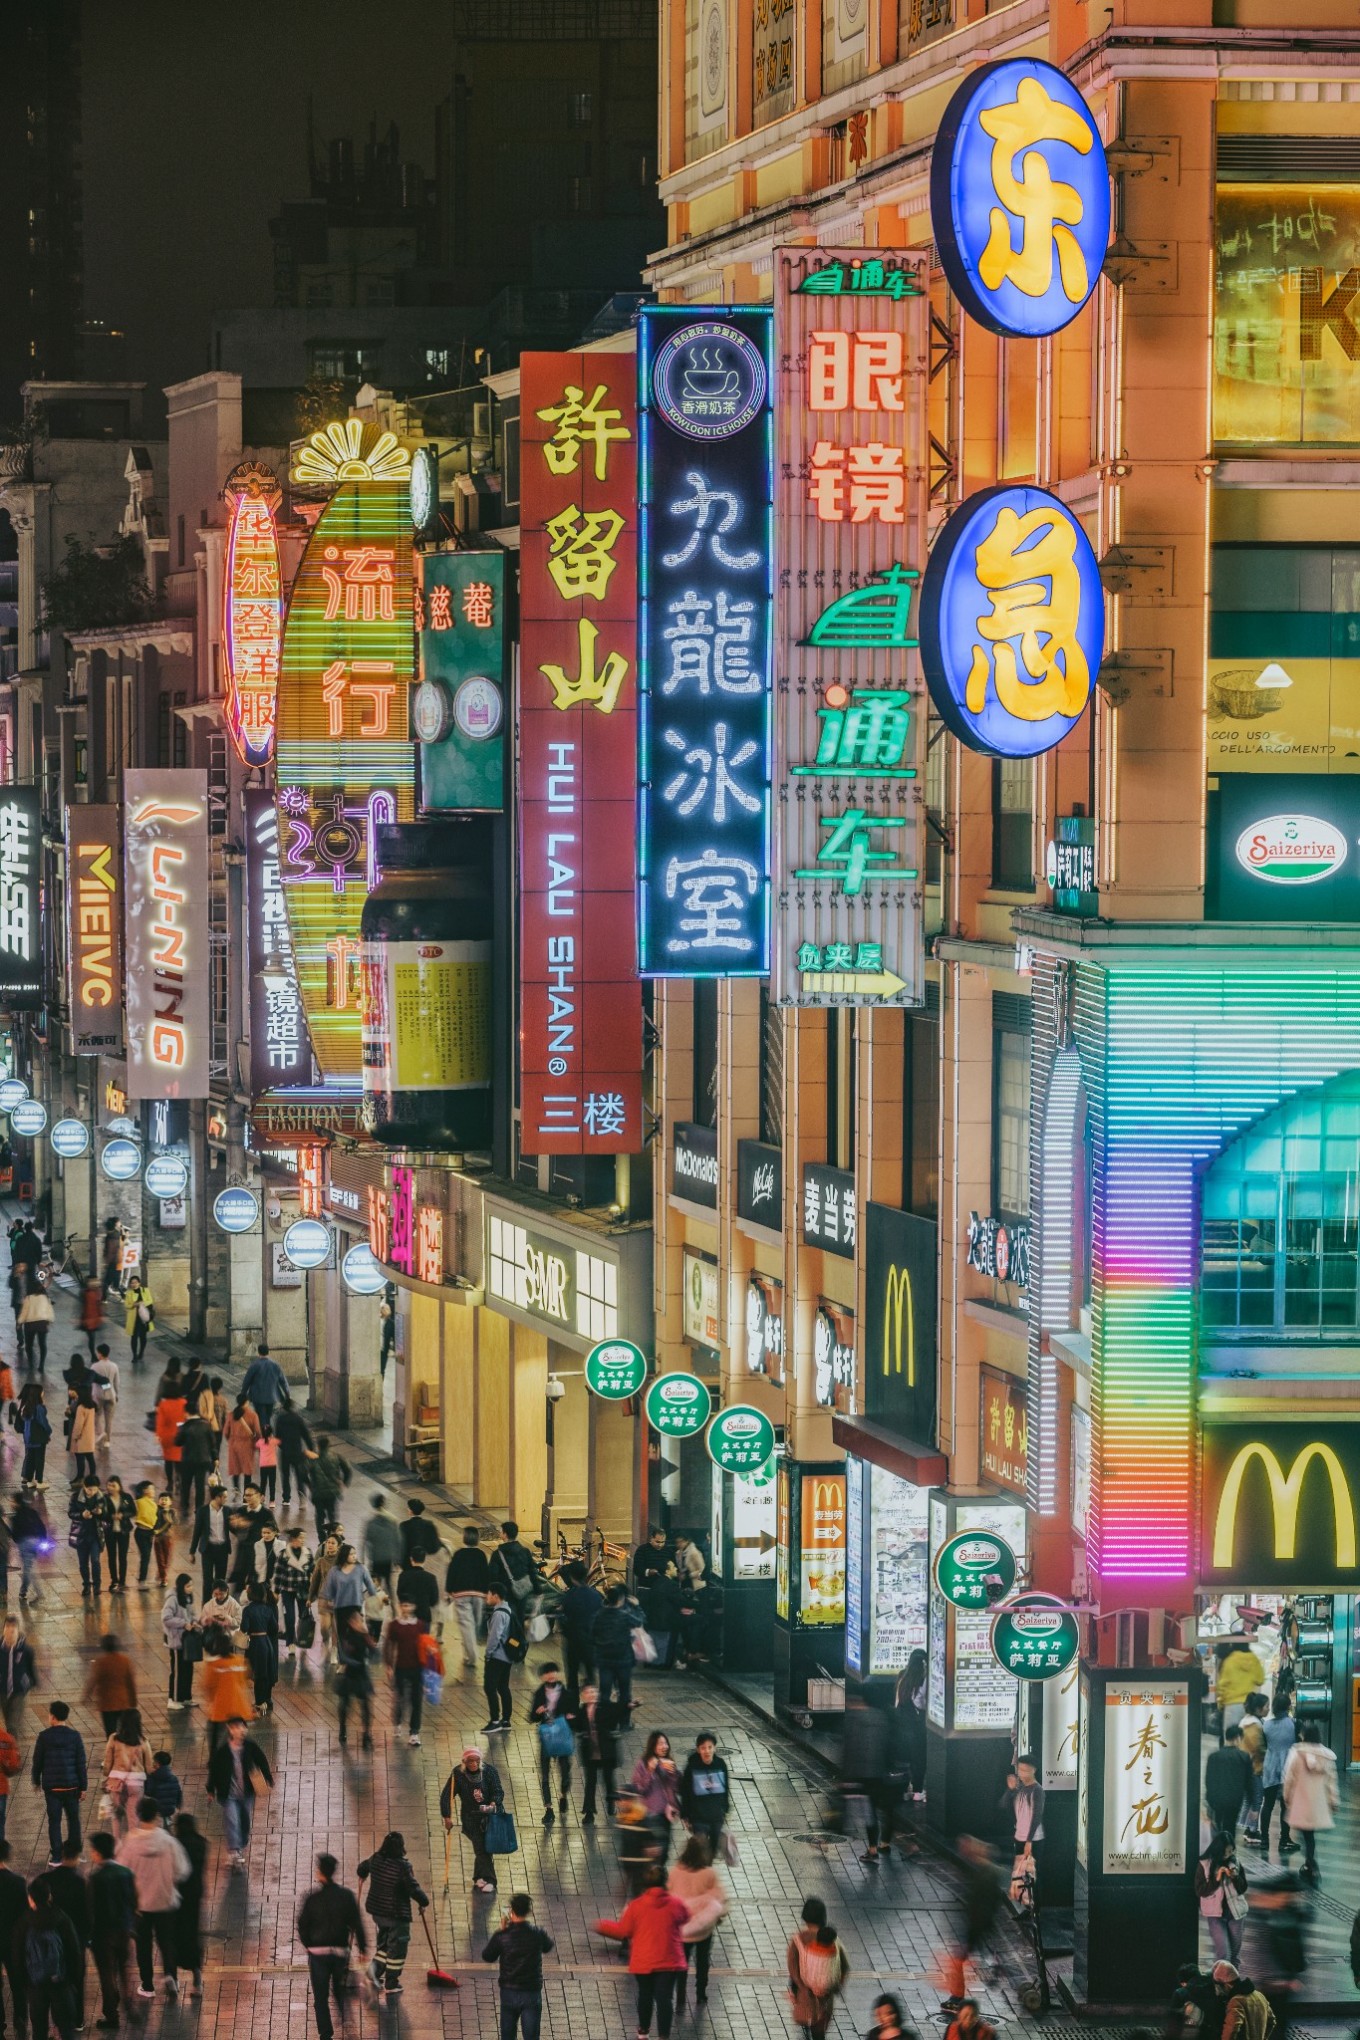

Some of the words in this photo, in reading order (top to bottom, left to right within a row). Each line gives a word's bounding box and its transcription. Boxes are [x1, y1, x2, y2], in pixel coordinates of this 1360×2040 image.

[668, 408, 711, 436] KOWLOON
[712, 408, 756, 436] ICEHOUSE
[1219, 743, 1337, 755] DELL'ARGOMENTO
[1246, 730, 1271, 741] USO
[547, 742, 576, 813] HUI
[1248, 835, 1337, 865] Saizeriya
[547, 833, 576, 916] LAU
[151, 846, 186, 1067] LI-NING
[538, 1092, 626, 1137] 三楼
[675, 1146, 718, 1187] McDonald's
[743, 1564, 771, 1576] 三楼
[1009, 1653, 1062, 1668] 萨莉亚
